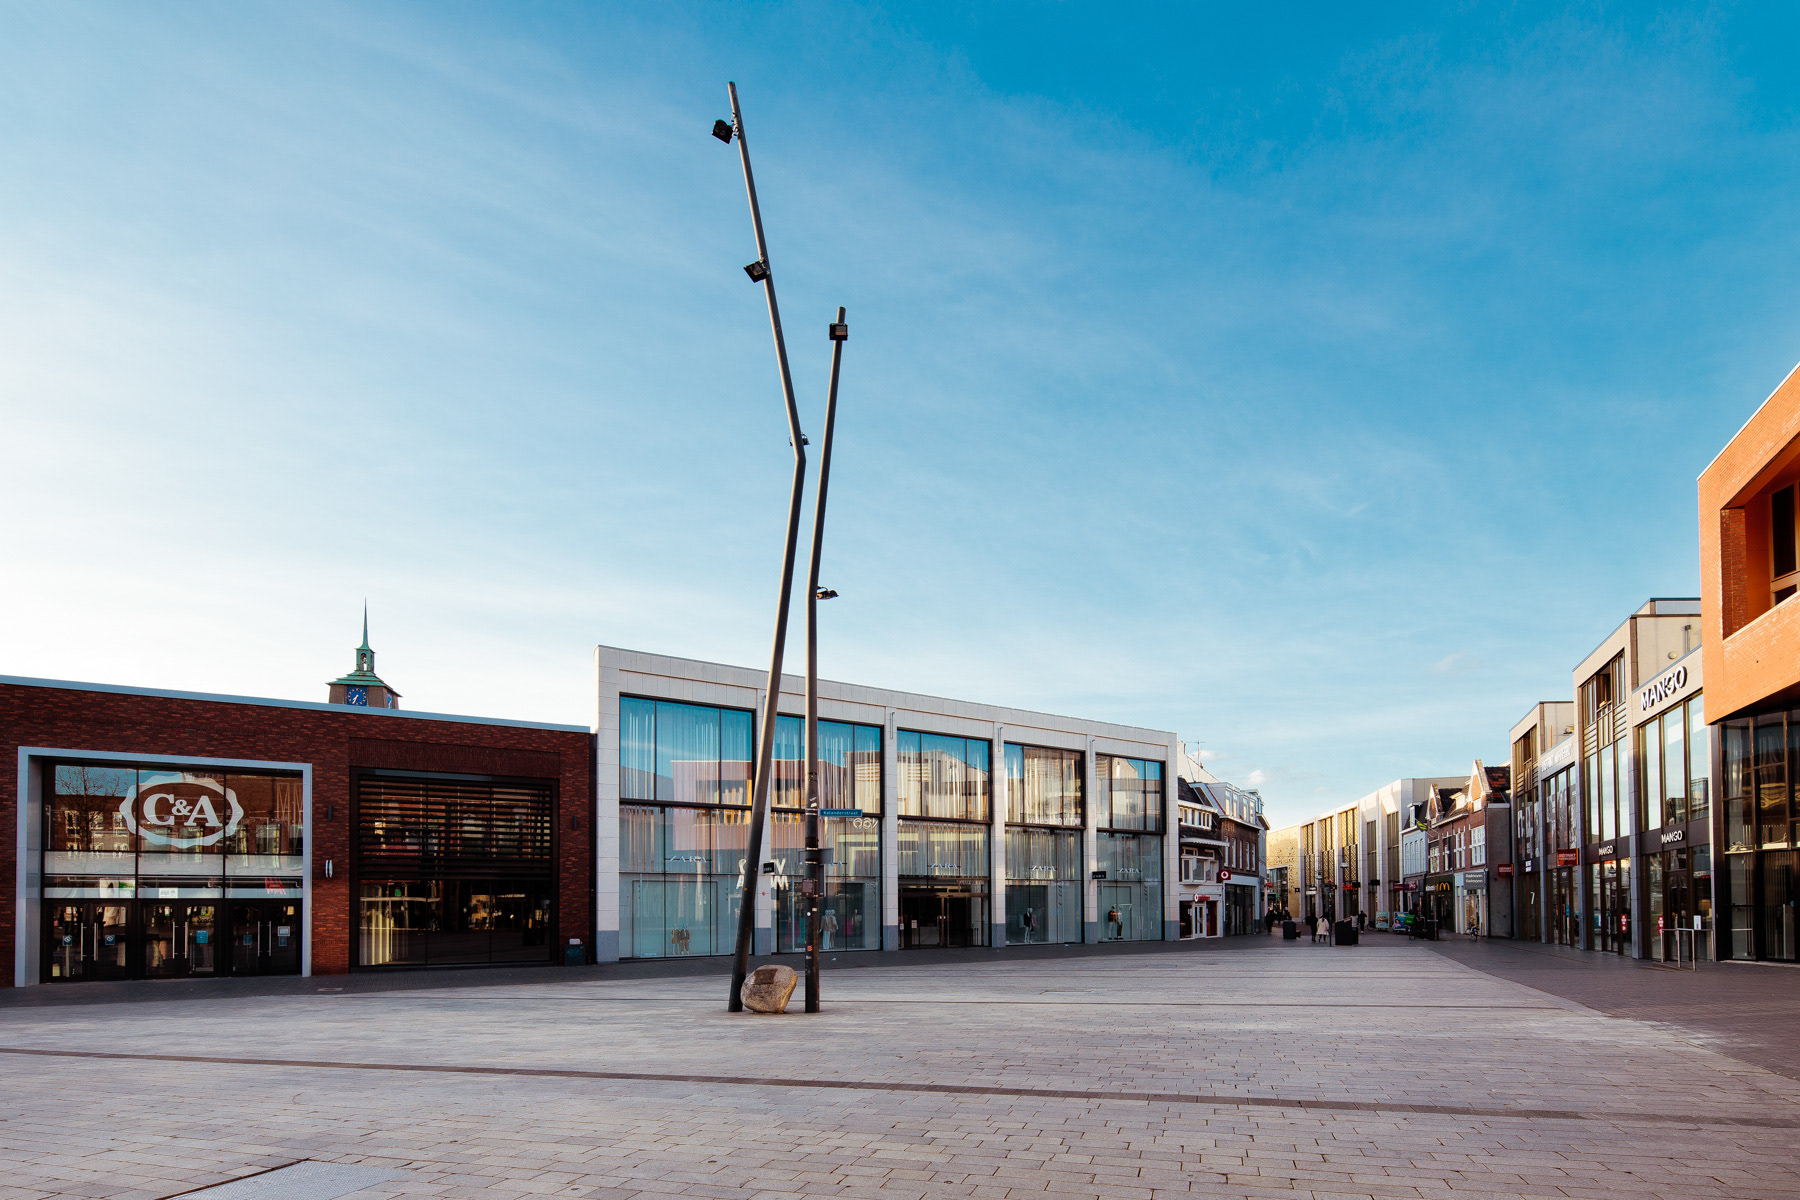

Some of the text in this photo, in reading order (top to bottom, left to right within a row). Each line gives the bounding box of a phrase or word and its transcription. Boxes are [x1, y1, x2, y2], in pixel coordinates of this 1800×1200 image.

[1640, 665, 1687, 711] MANGO
[143, 793, 223, 827] C&A
[1661, 830, 1683, 845] MANGO
[1598, 845, 1614, 856] MANGO
[930, 862, 959, 870] ZARA
